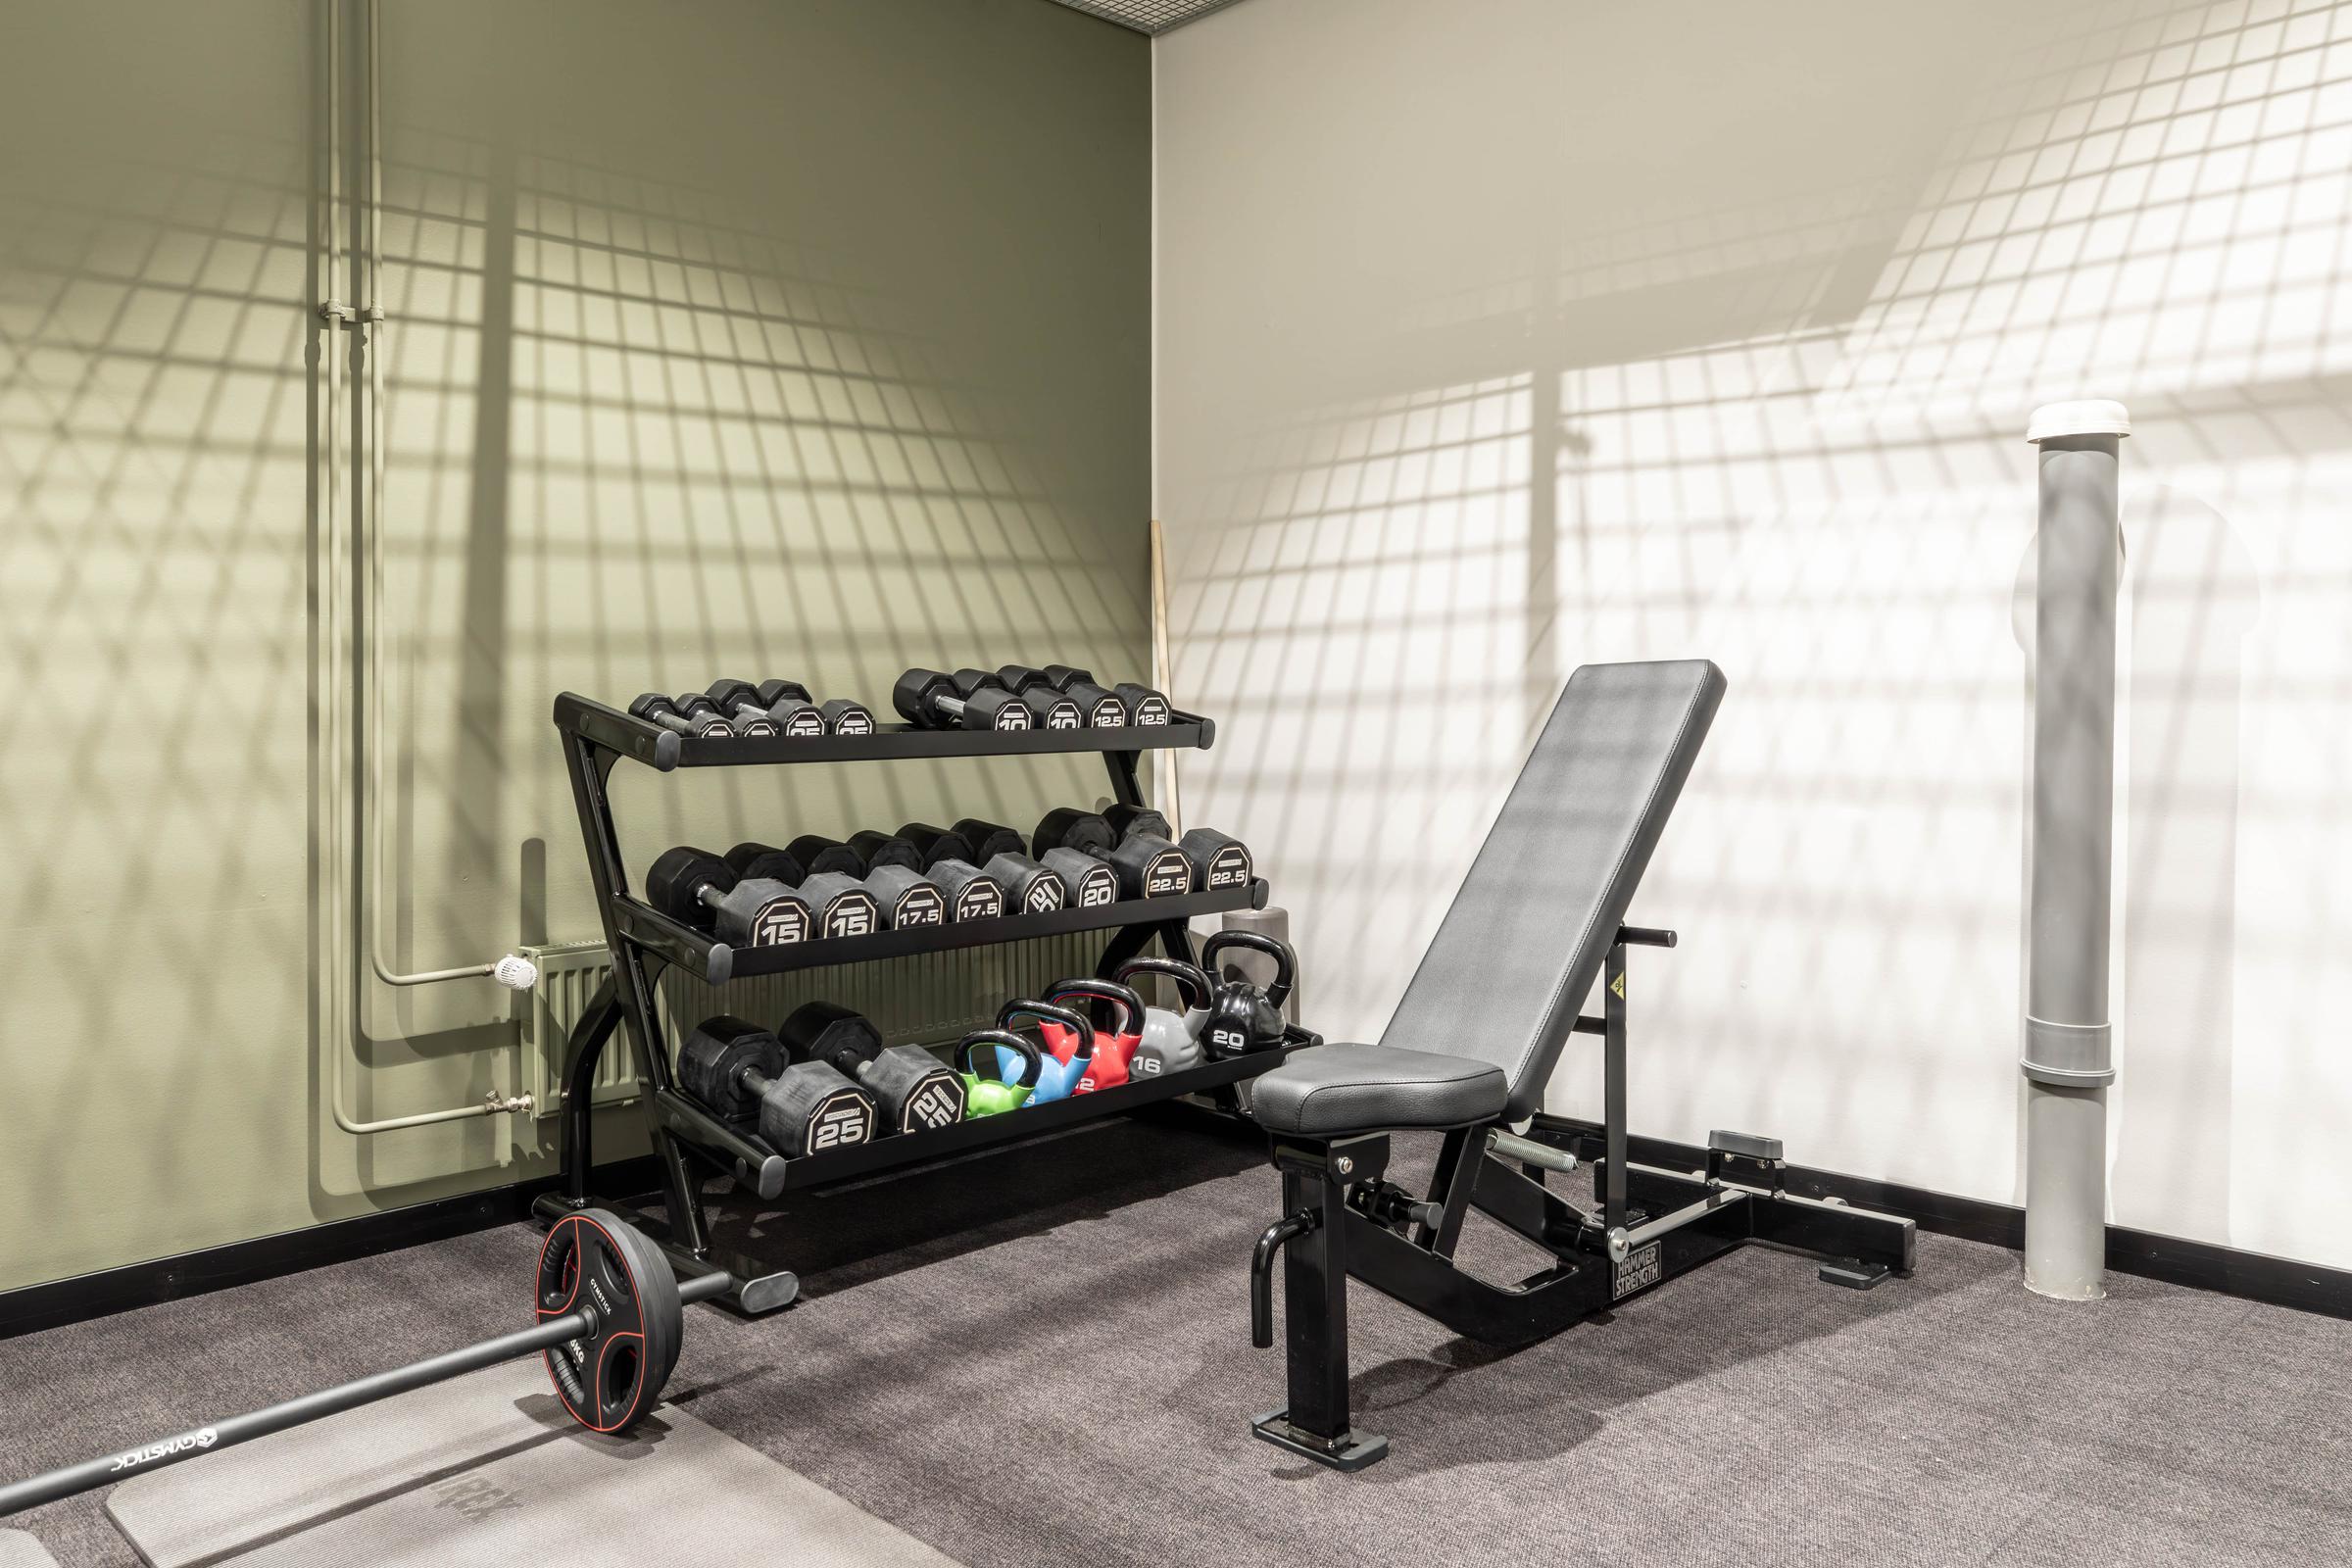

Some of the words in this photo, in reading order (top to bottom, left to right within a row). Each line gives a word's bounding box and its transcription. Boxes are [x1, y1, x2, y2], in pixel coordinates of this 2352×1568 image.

[1095, 715, 1123, 727] 12.5
[1139, 713, 1166, 725] 12.5
[1149, 876, 1187, 893] 22.5
[1210, 869, 1246, 885] 22.5
[1083, 886, 1111, 907] 20
[899, 908, 940, 926] 17.5
[960, 902, 999, 918] 17.5
[760, 923, 801, 946] 15
[831, 914, 868, 937] 15
[1213, 1029, 1245, 1048] 20
[1132, 1055, 1161, 1074] 16
[912, 1091, 953, 1129] 25
[814, 1117, 864, 1150] 25
[1618, 1247, 1656, 1280] HAMMER
[1616, 1261, 1658, 1297] STRENGTH
[590, 1278, 612, 1315] GYMSTICK
[111, 1435, 197, 1472] GYMSTICK
